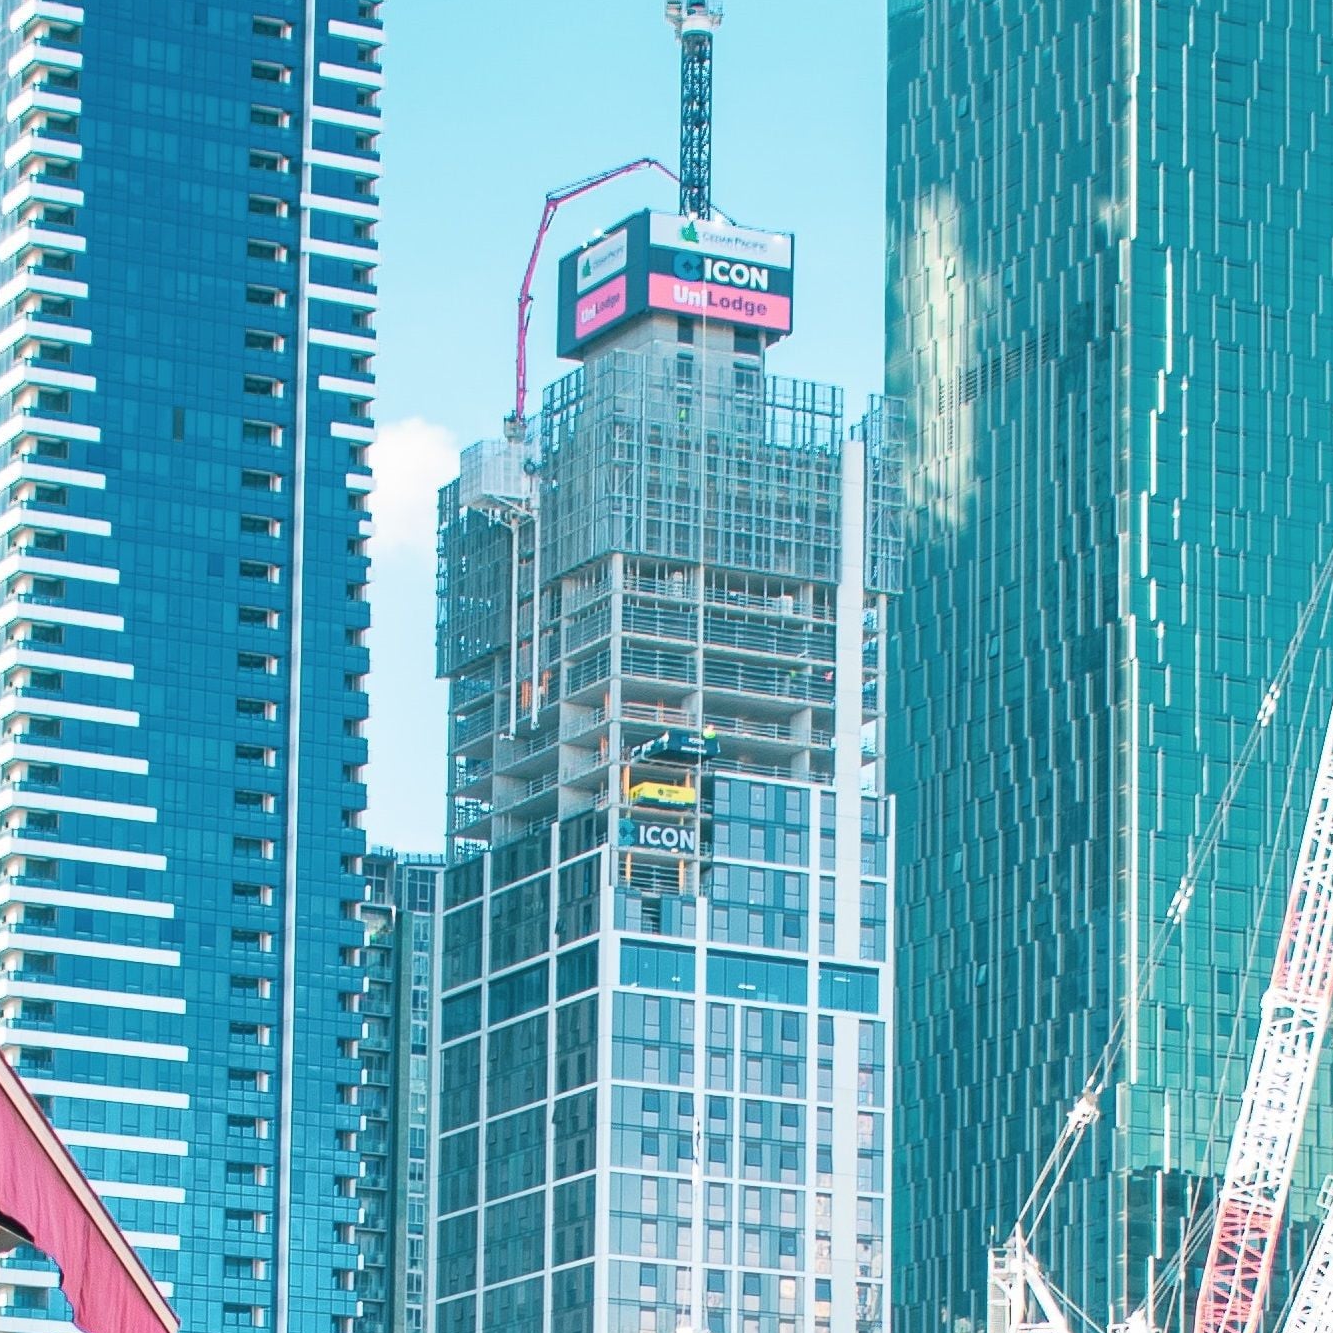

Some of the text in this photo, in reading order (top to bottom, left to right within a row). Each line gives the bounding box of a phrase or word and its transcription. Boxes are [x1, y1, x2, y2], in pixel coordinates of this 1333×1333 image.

[704, 257, 768, 292] ICON
[673, 284, 768, 317] UniLodge
[639, 824, 695, 851] ICON
